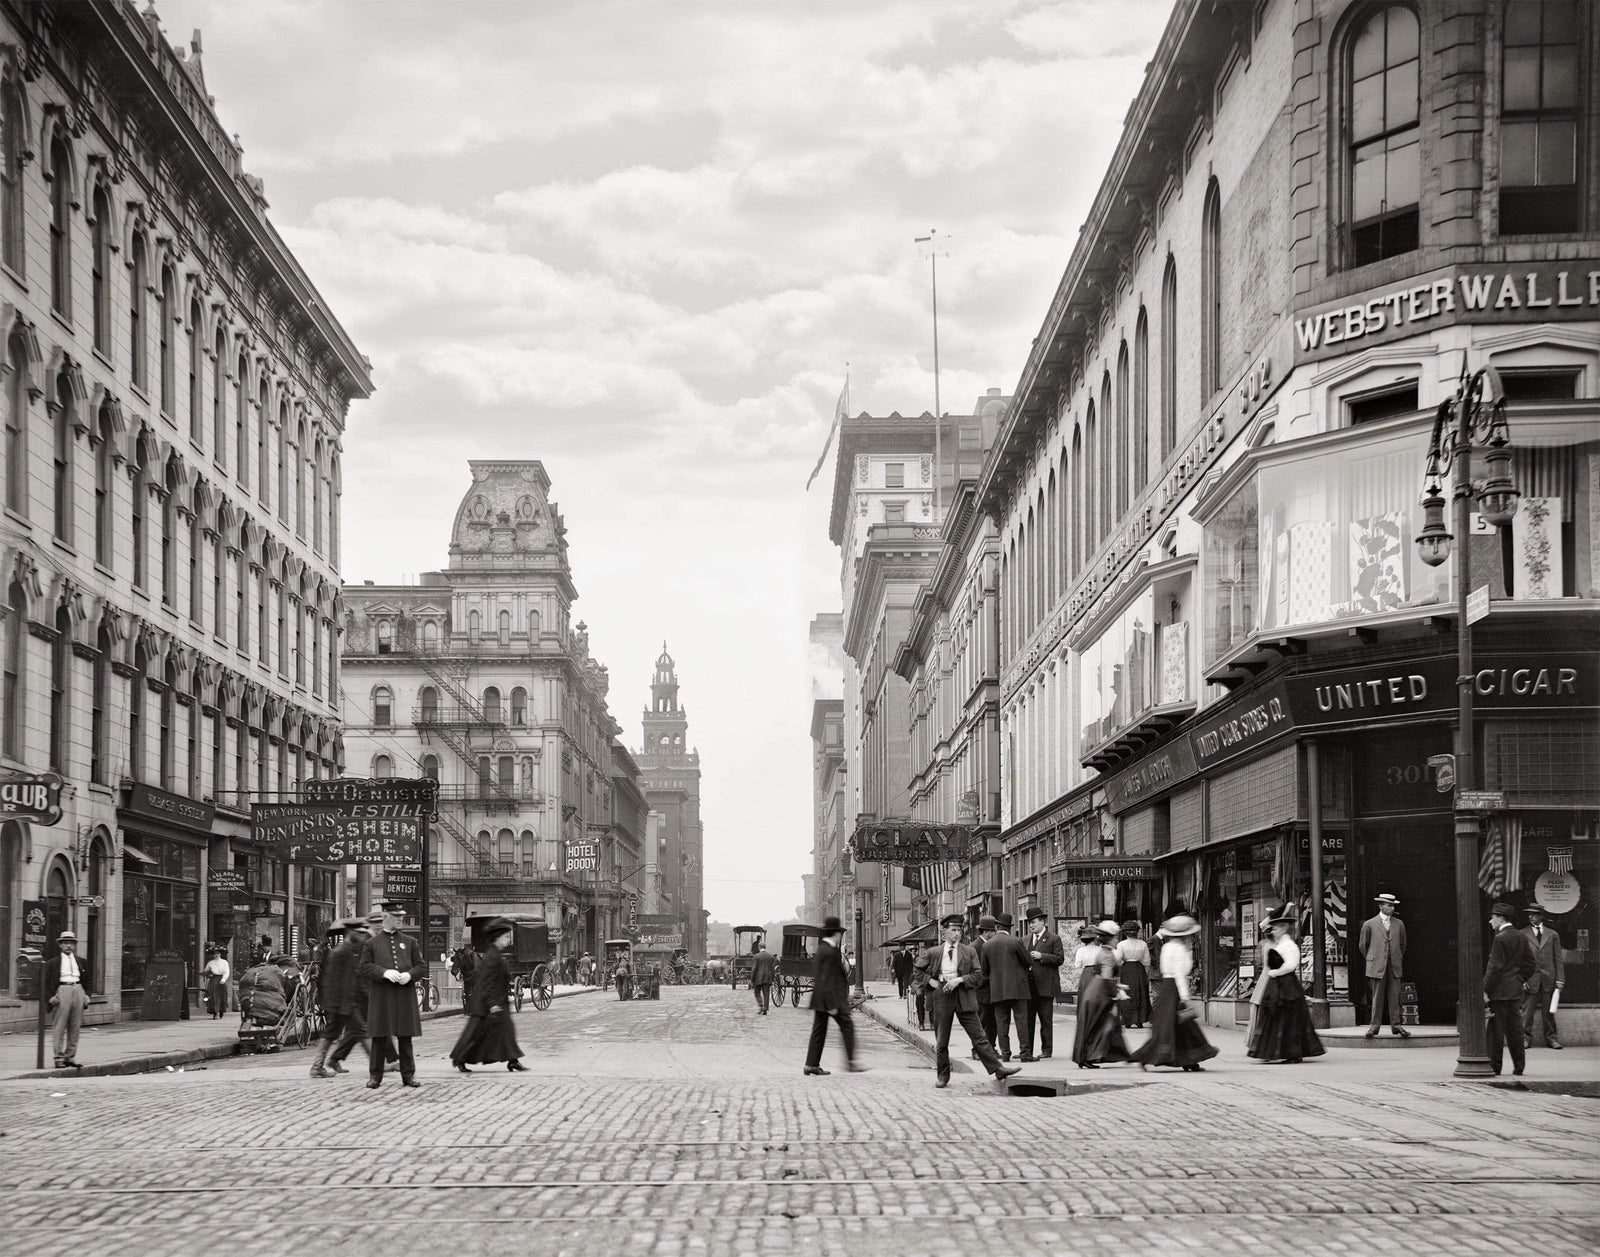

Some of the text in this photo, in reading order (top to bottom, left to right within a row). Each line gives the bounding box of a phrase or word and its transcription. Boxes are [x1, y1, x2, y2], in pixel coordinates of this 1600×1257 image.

[1295, 278, 1456, 352] WEBSTER
[1315, 668, 1578, 712] UNITED CIGAR
[1, 784, 48, 811] CLUB
[343, 784, 432, 800] DENTISTS
[256, 807, 307, 822] NEW YORK
[351, 804, 424, 818] ESTILL
[255, 813, 336, 841] DENTISTS
[307, 833, 333, 842] 307
[871, 830, 954, 847] CLAY
[1302, 838, 1343, 849] CARS
[327, 839, 396, 861] SHOE
[568, 845, 596, 858] HOTEL
[568, 858, 597, 870] BOODY
[1102, 867, 1142, 877] HOUGH
[387, 884, 417, 894] DENTIST
